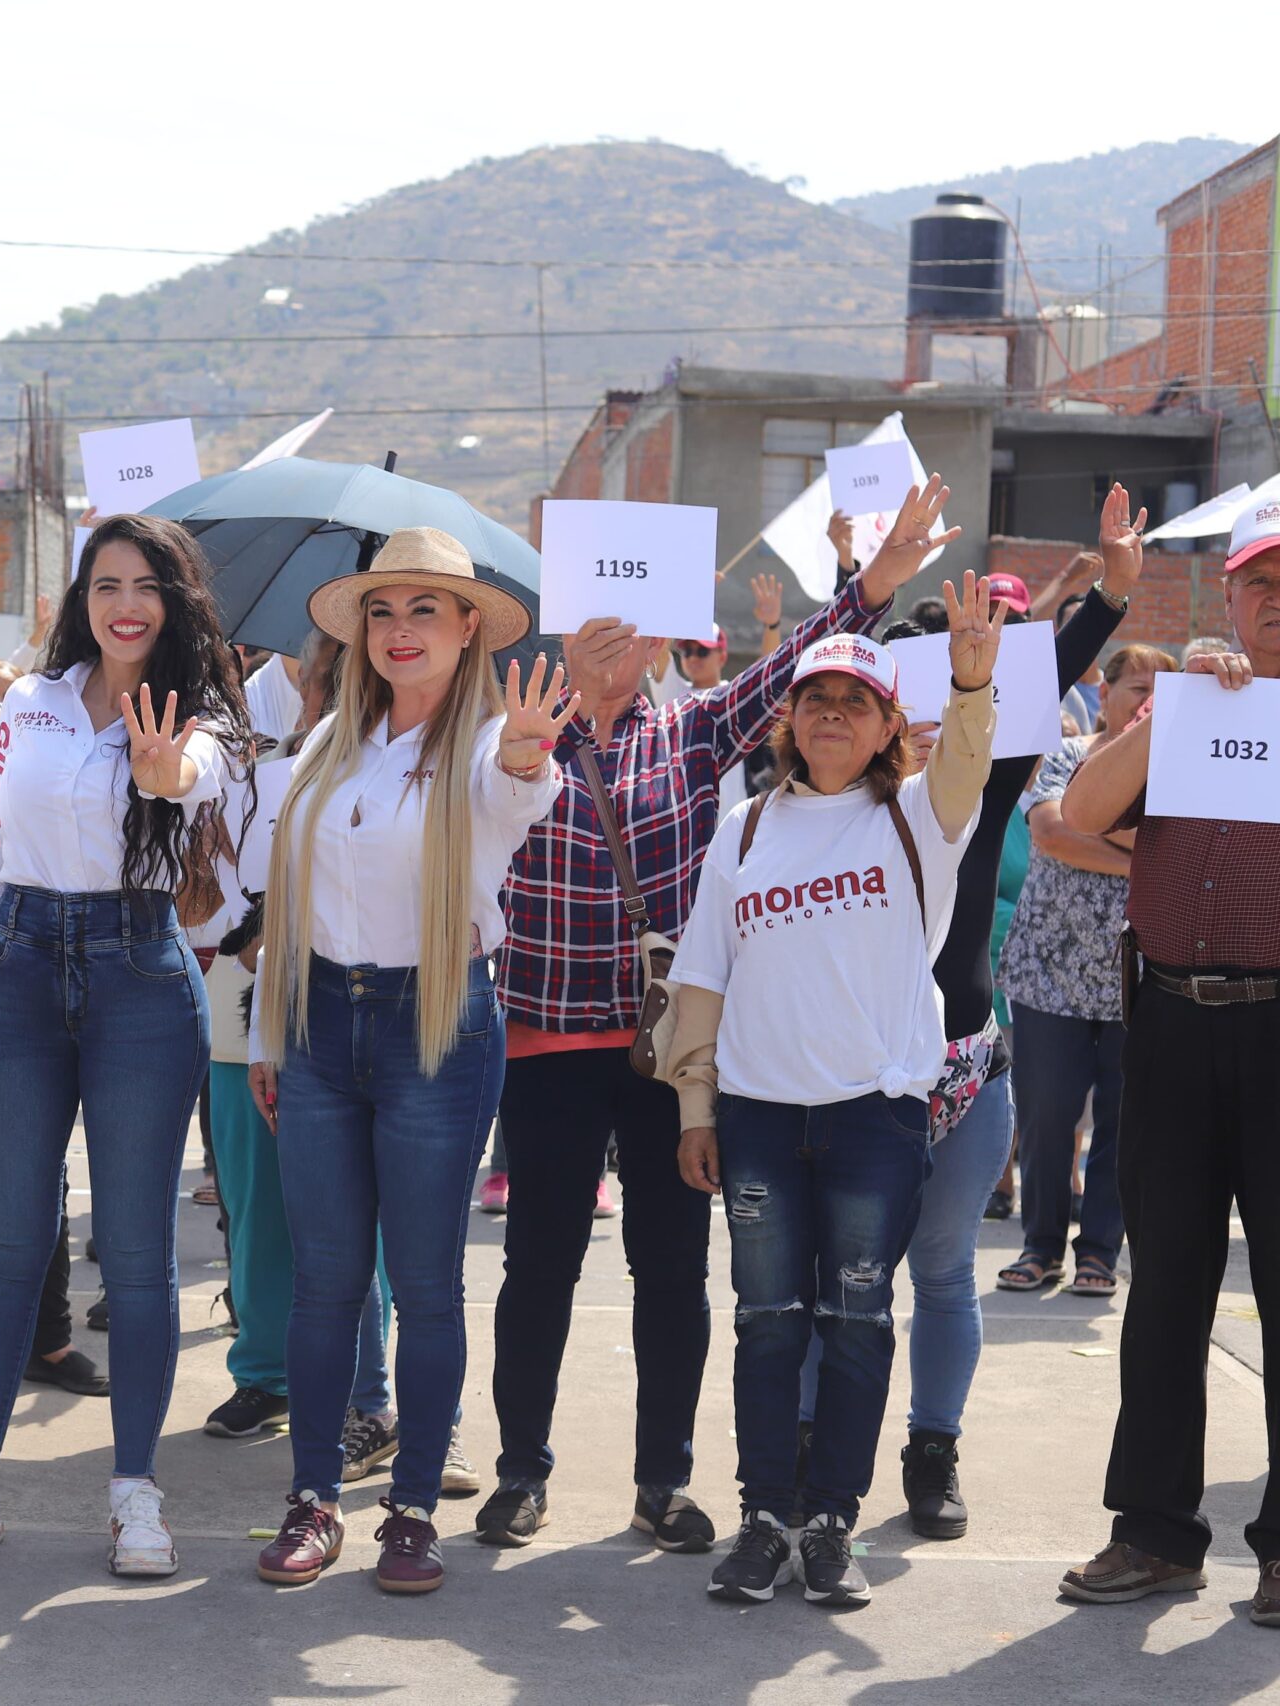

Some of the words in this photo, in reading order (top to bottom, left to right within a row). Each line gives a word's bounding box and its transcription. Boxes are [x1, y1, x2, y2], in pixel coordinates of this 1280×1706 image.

[118, 465, 154, 482] 1028
[852, 474, 880, 488] 1039
[595, 559, 648, 579] 1195
[815, 644, 875, 661] CLAUDIA
[1210, 739, 1269, 761] 1032
[735, 866, 886, 928] morena
[739, 896, 889, 941] MICHOACÁN
